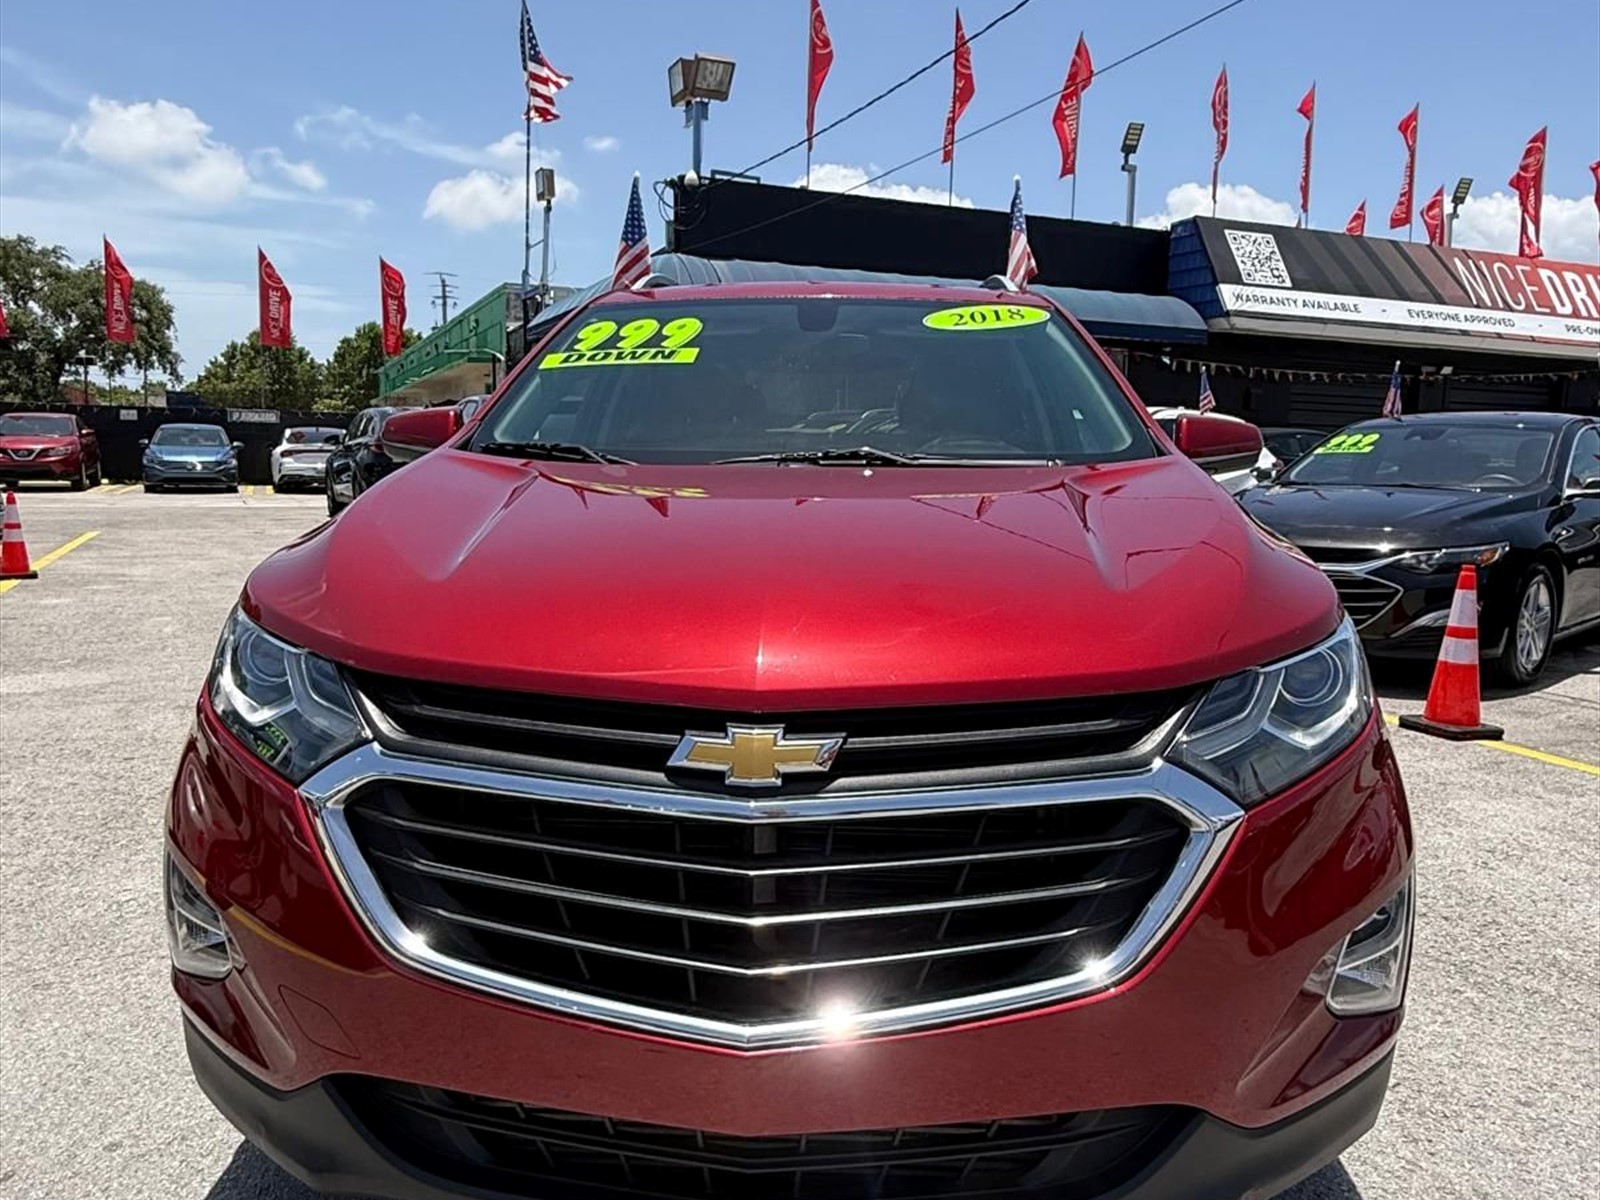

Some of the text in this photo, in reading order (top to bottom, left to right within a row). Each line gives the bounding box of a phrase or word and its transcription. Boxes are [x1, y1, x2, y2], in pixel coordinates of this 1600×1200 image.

[1232, 292, 1362, 314] WARRANTY AVAILABLE
[949, 307, 1025, 327] 2018
[1407, 308, 1516, 328] EVERYONE APPROVED
[573, 317, 703, 351] 999
[559, 349, 681, 365] DOWN
[1326, 433, 1380, 449] 999
